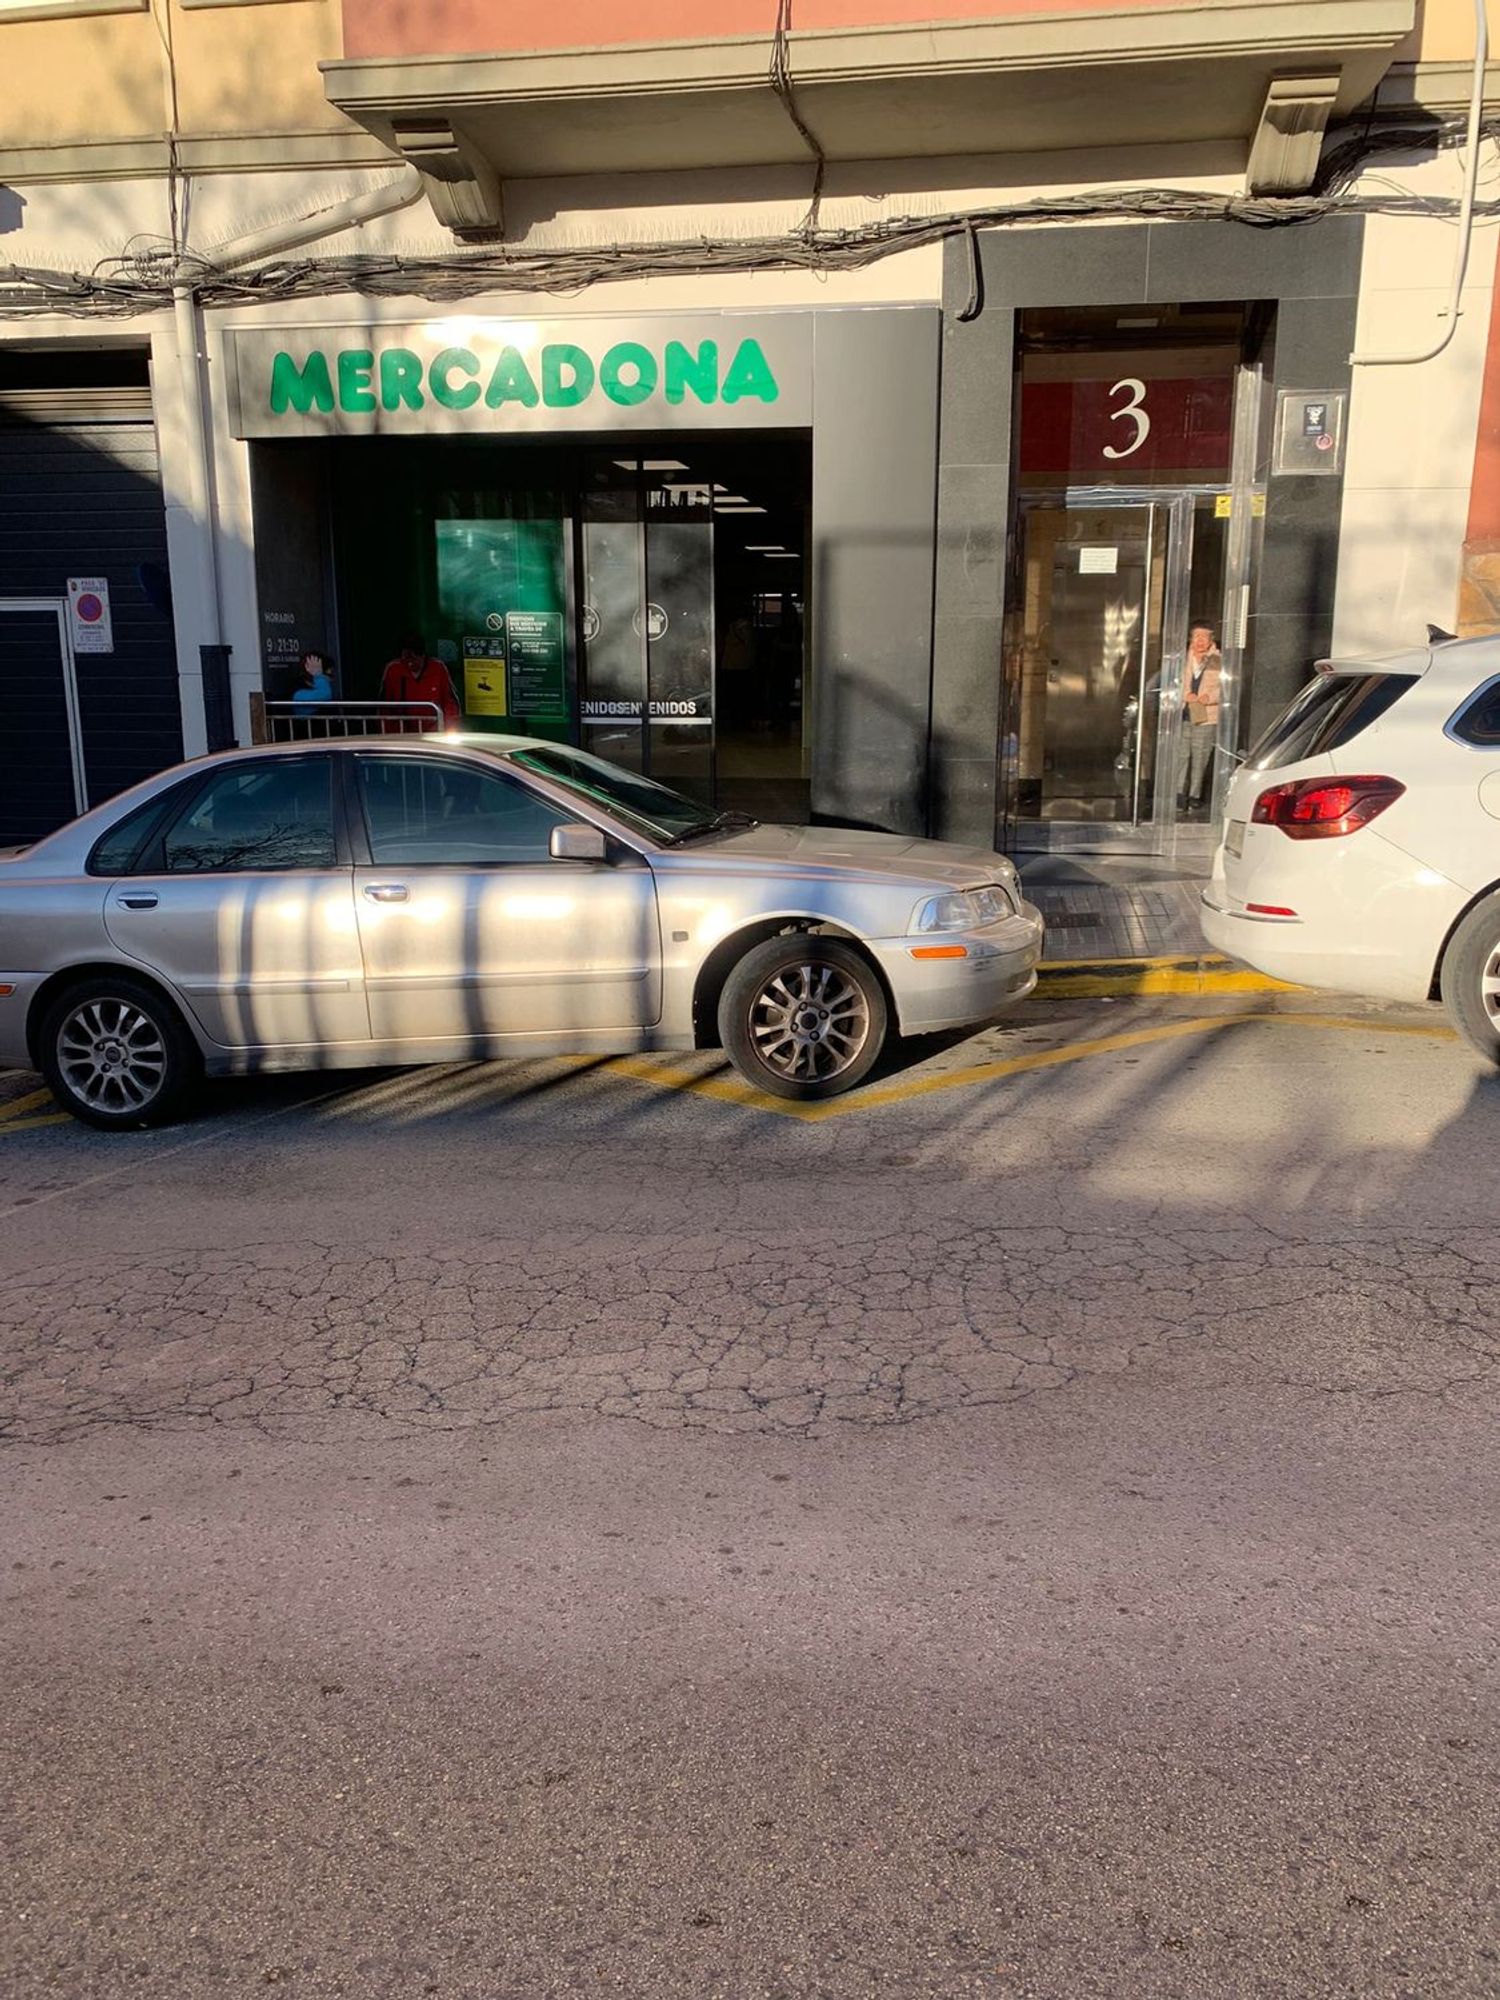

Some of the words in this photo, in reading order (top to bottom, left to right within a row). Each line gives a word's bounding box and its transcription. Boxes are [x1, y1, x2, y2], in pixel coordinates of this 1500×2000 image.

[271, 338, 779, 414] MERCADONA
[1102, 378, 1150, 459] 3
[264, 611, 296, 624] HORARIO
[266, 637, 273, 652] 9
[648, 701, 697, 715] ENIDOS
